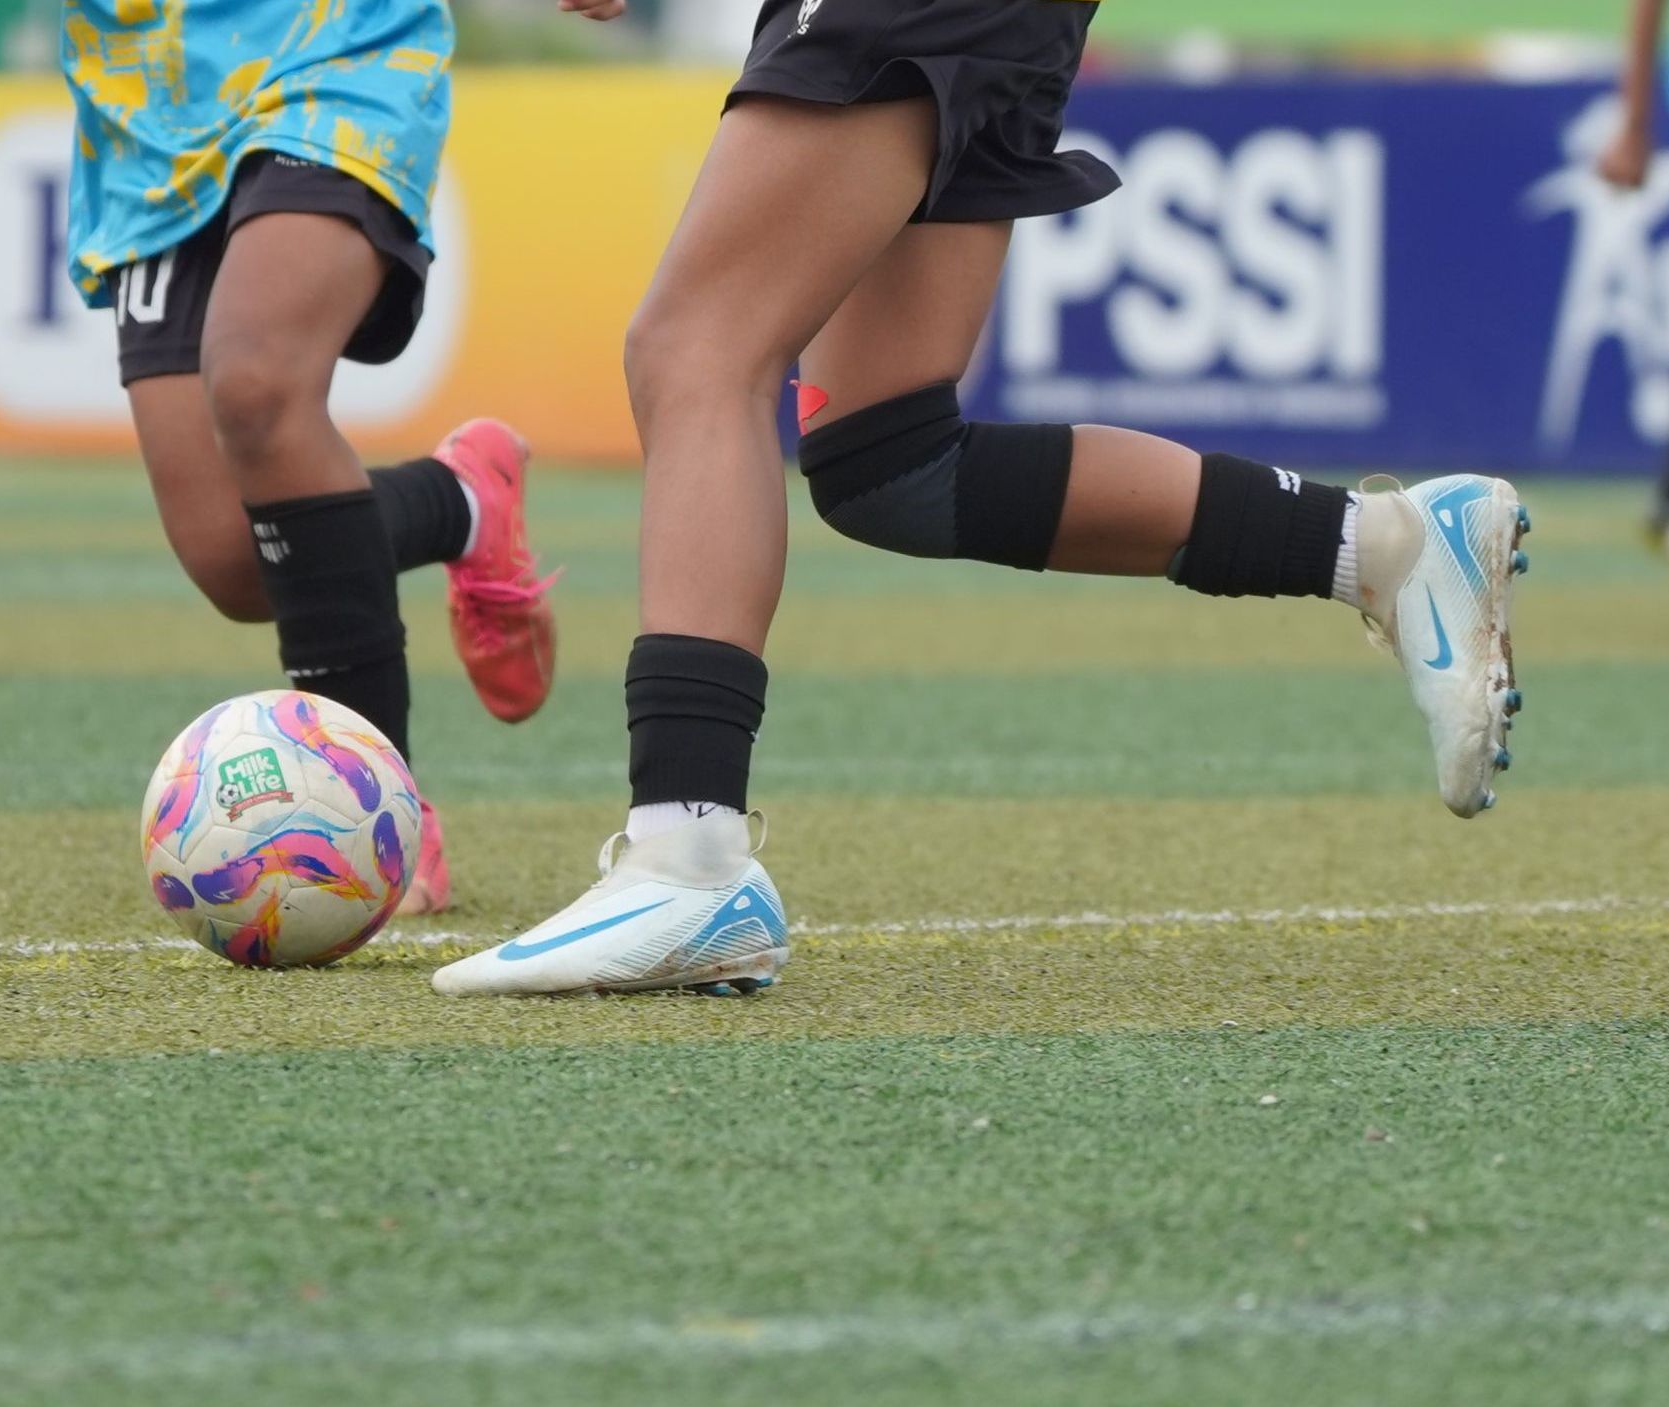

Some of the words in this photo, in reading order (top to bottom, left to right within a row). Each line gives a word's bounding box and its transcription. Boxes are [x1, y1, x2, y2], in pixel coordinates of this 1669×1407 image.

[1002, 127, 1386, 380] PSSI
[225, 754, 275, 782] Milk
[238, 772, 282, 800] Life
